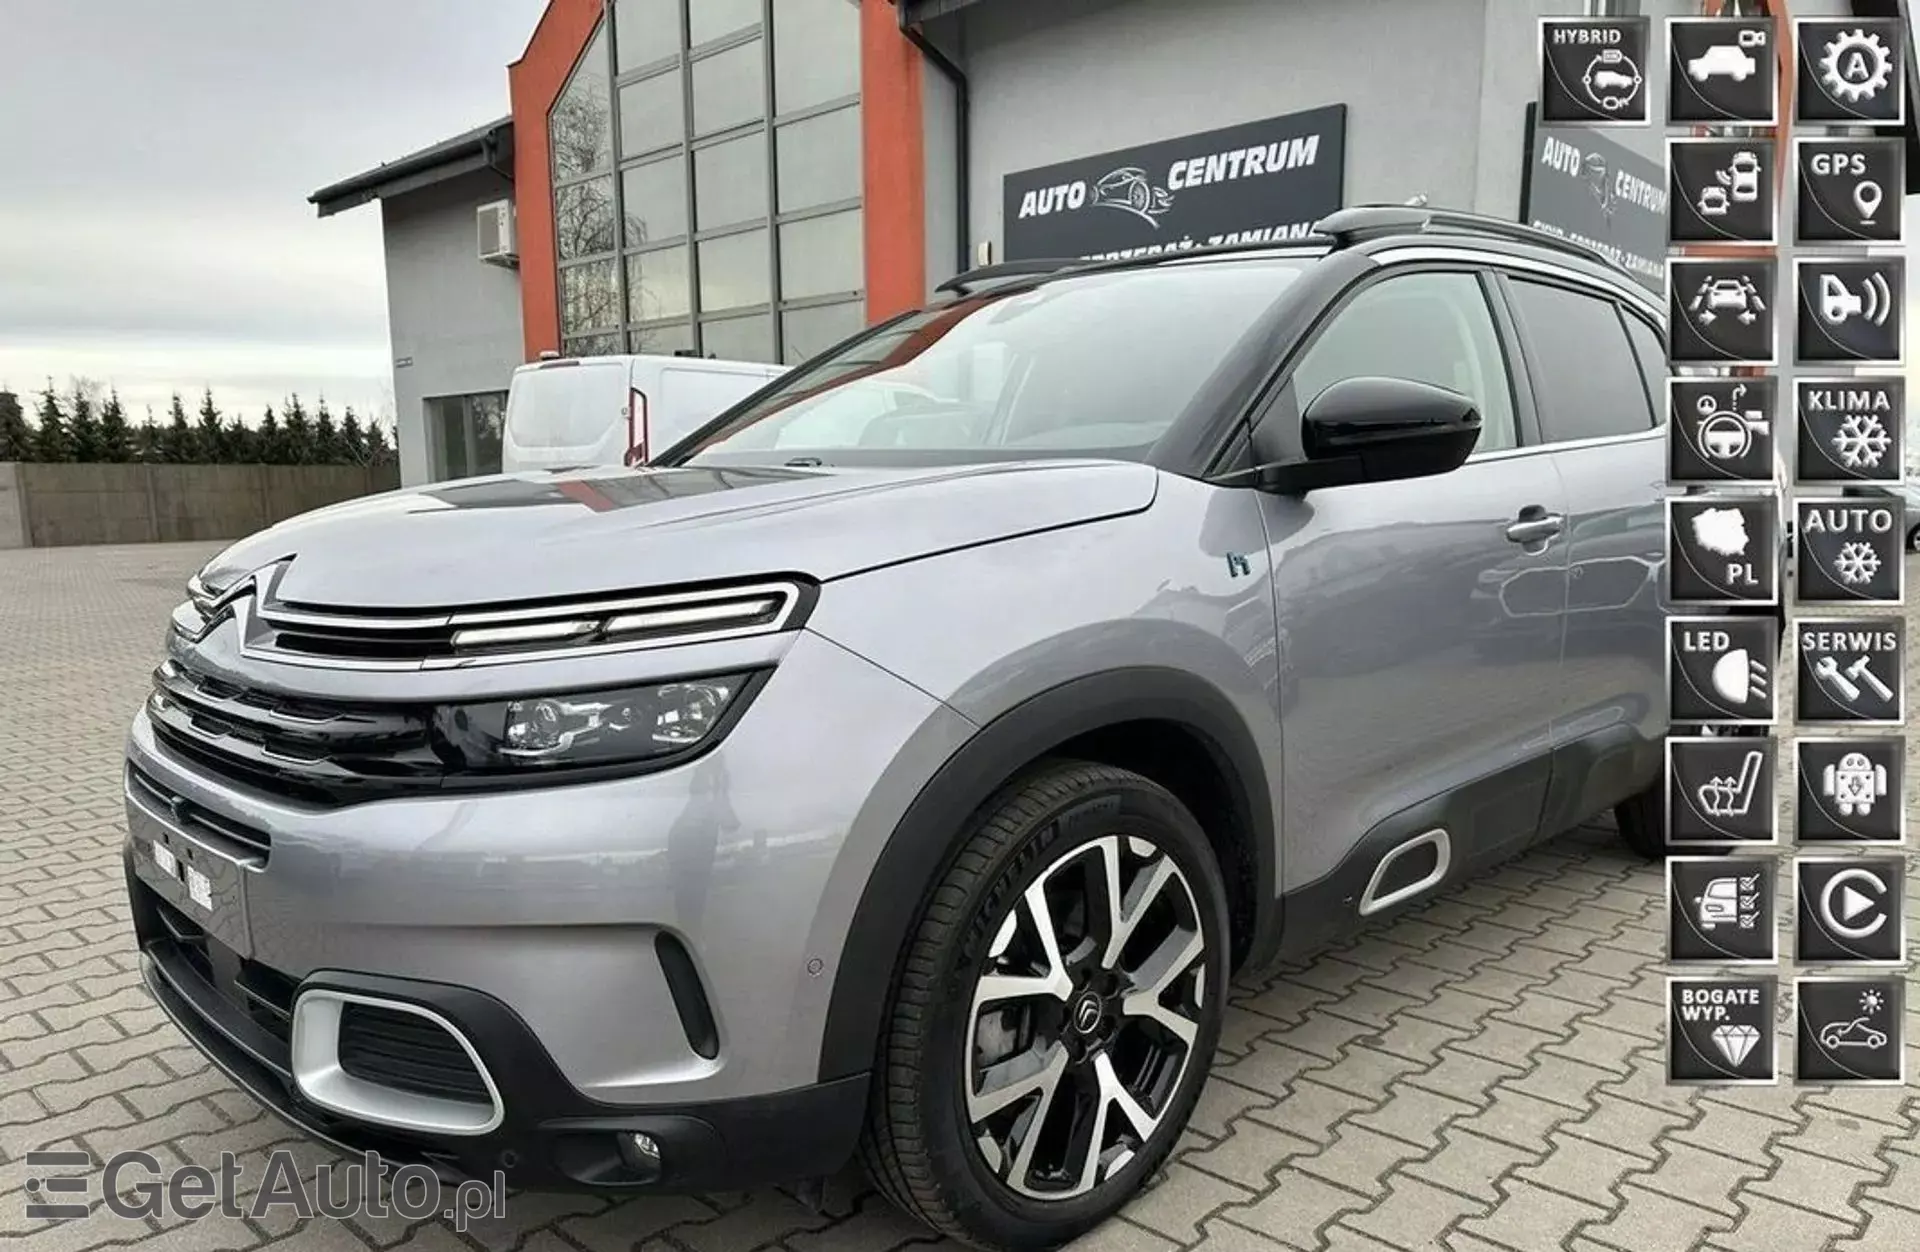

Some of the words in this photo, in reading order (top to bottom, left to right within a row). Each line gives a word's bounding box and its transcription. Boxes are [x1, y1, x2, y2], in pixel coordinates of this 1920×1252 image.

[1018, 181, 1087, 218] AUTO
[1167, 135, 1320, 191] CENTRUM
[1541, 136, 1580, 177] AUTO
[1615, 169, 1668, 216] CENTRUM
